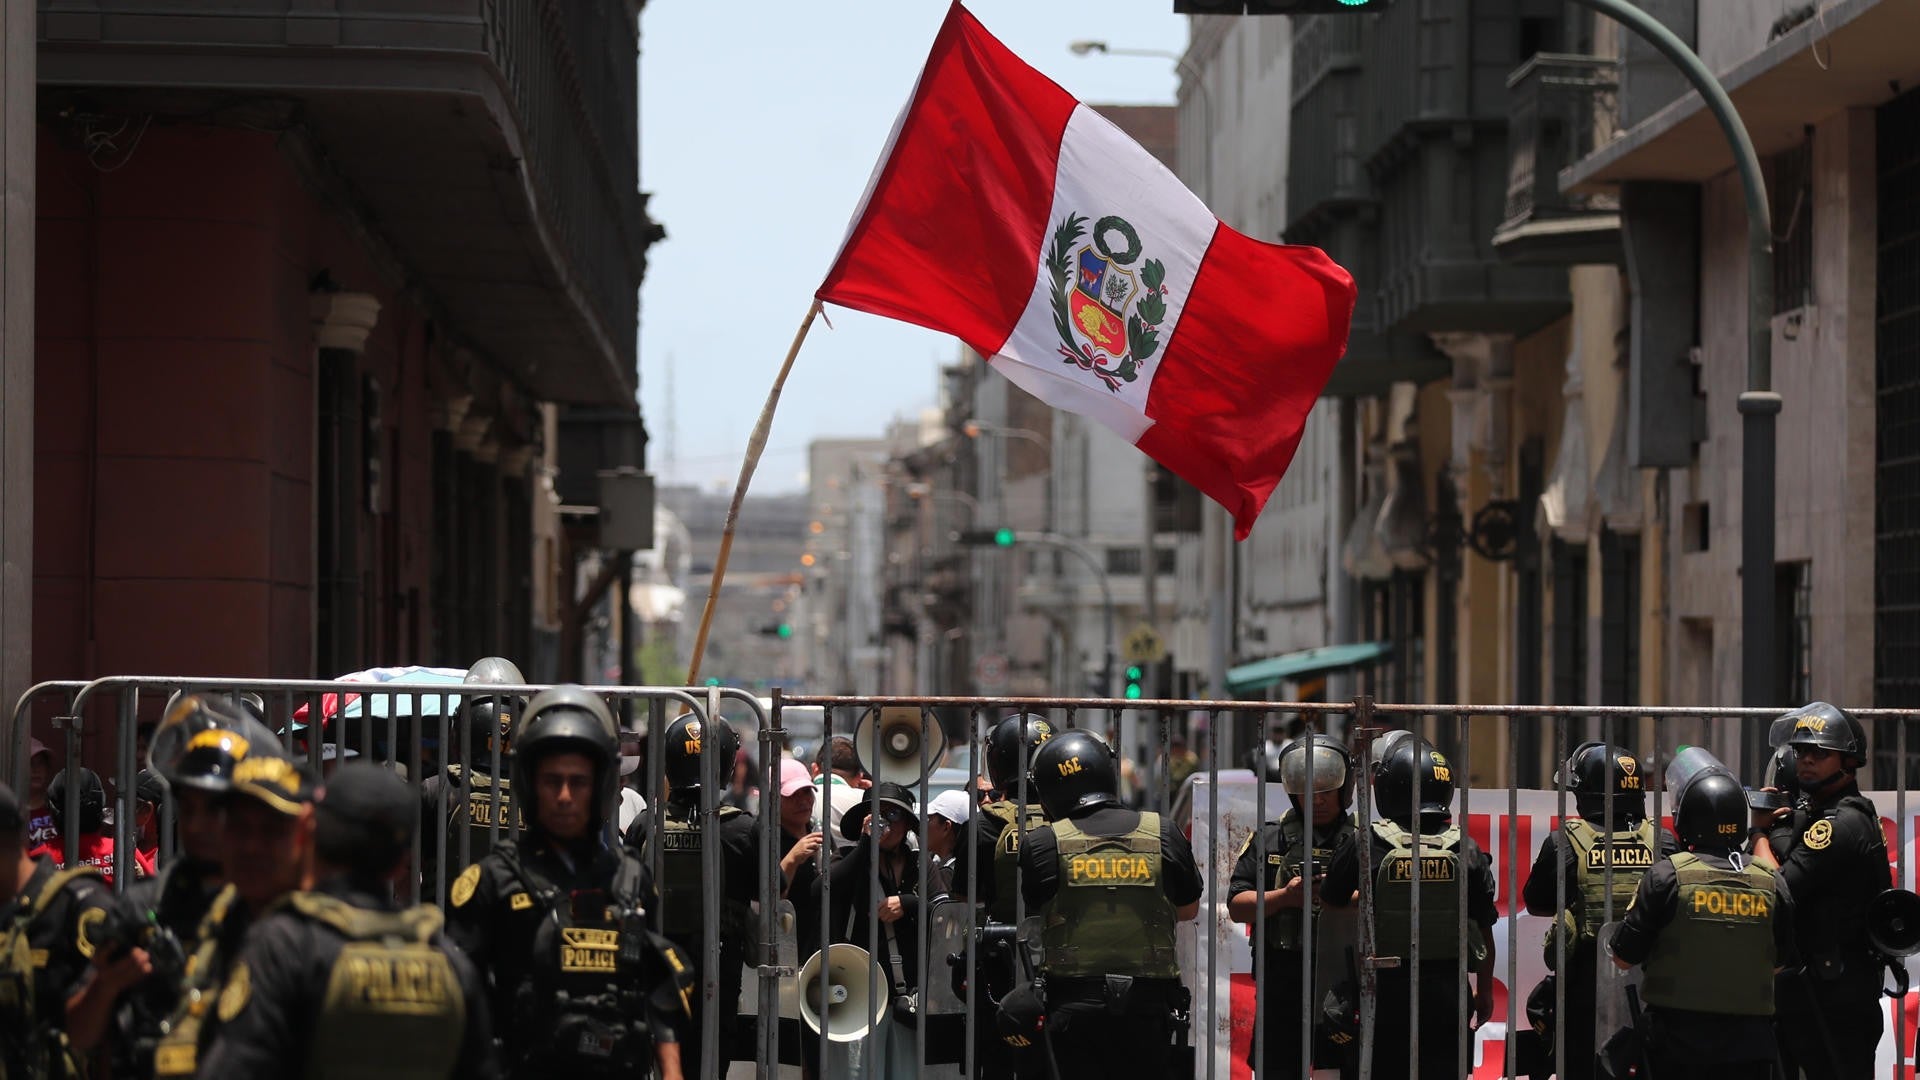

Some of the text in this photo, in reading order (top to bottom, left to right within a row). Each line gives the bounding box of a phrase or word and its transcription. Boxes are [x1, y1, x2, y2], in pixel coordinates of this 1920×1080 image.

[684, 740, 702, 754] US
[1058, 757, 1081, 777] USE
[1433, 766, 1450, 782] USE
[1718, 824, 1738, 834] USE
[1072, 857, 1150, 879] POLICIA
[1694, 890, 1768, 917] POLICIA
